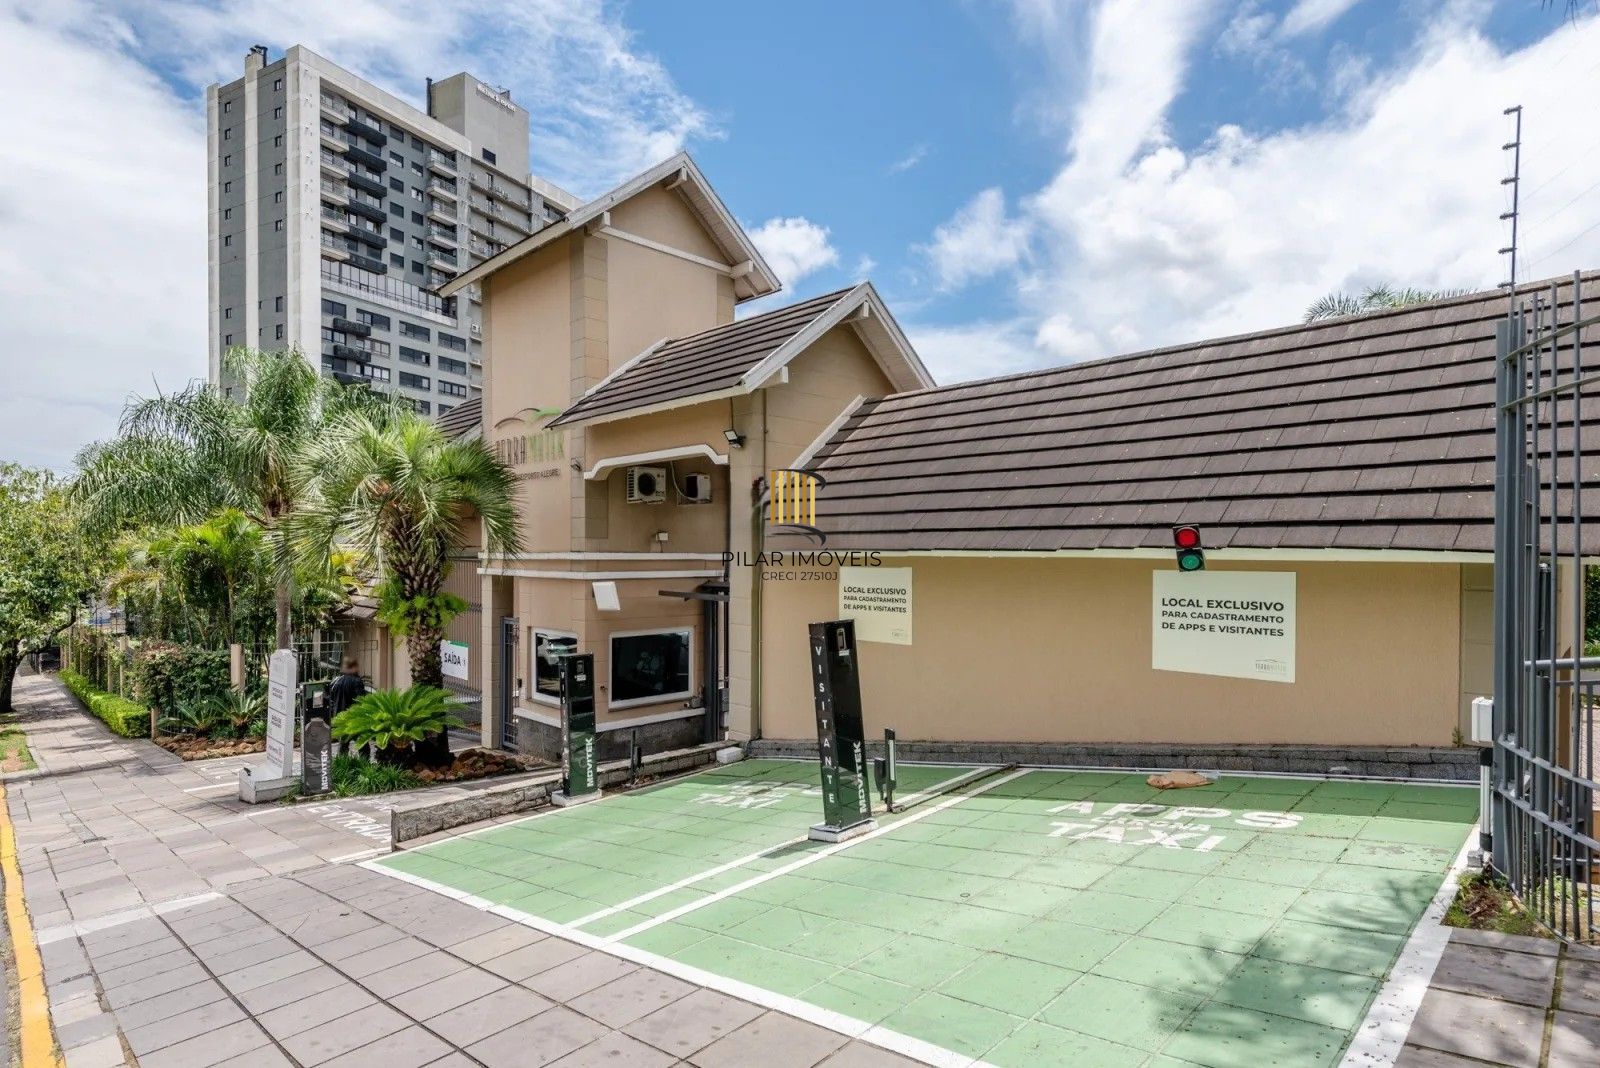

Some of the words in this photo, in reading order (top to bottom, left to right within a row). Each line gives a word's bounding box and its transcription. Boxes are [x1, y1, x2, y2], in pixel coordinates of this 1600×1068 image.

[843, 586, 865, 594] LOCAL
[867, 587, 907, 596] EXCLUSIVO
[858, 596, 907, 604] CADASTRAMENTO
[1162, 598, 1203, 608] LOCAL
[1206, 600, 1284, 612] EXCLUSIVO
[873, 605, 907, 614] VISITANTES
[1190, 612, 1284, 624] CADASTRAMENTO
[1162, 622, 1176, 630] DE
[1178, 623, 1206, 632] APPS
[1209, 625, 1216, 633] E
[1218, 625, 1284, 637] VISITANTES
[444, 652, 461, 666] SAÍDA
[815, 646, 834, 803] VISITANTE
[586, 737, 594, 788] MOVITEK
[853, 740, 867, 814] MOVITEK
[1046, 801, 1304, 829] APPS
[1047, 821, 1227, 853] TAXI
